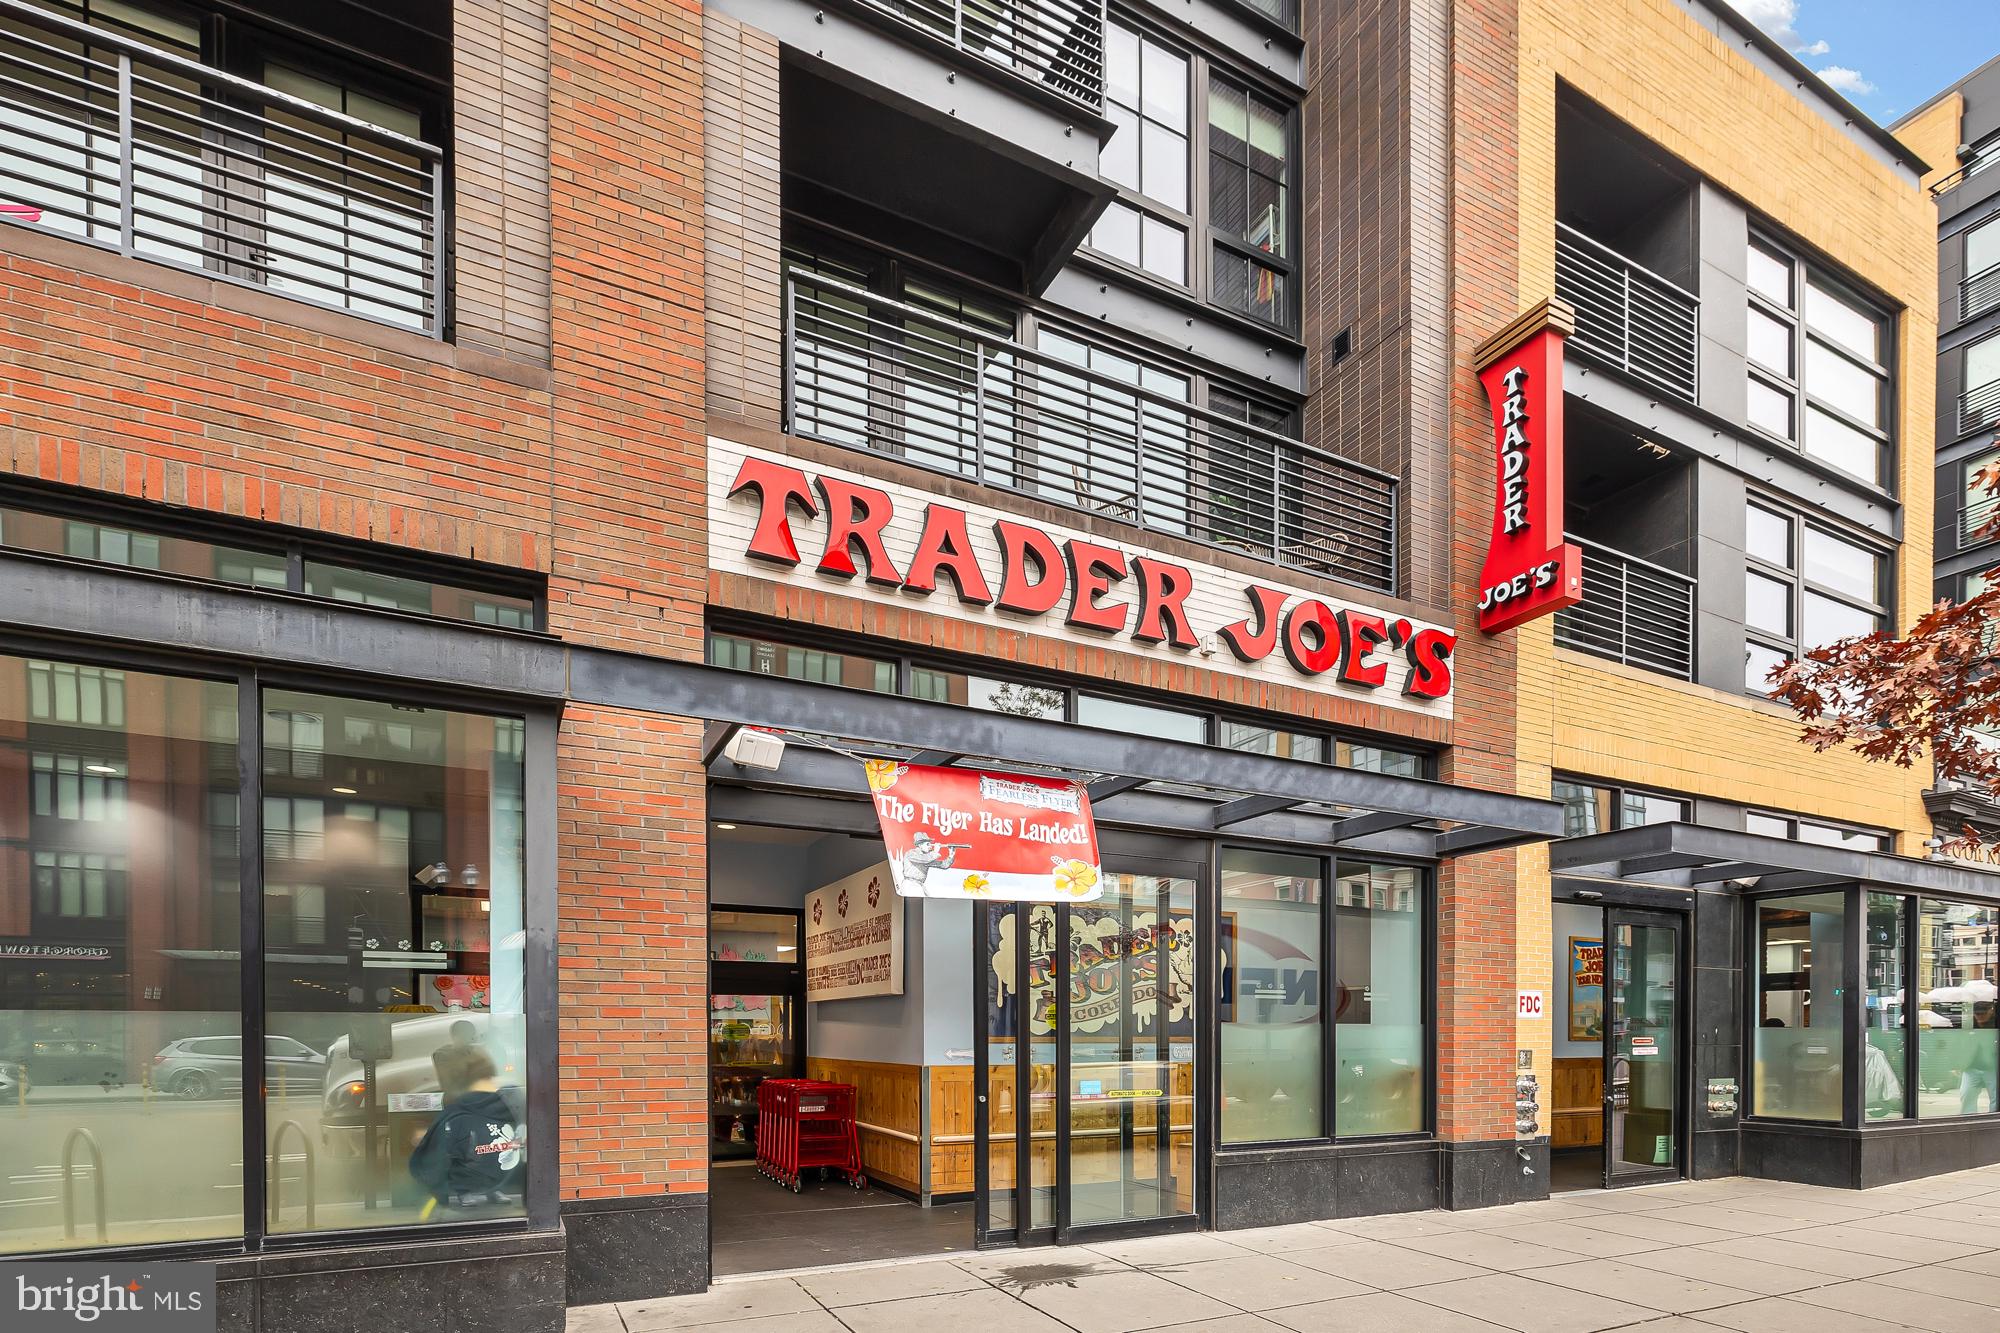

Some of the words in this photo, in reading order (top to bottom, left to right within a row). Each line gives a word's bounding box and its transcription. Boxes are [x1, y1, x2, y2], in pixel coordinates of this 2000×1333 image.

[1501, 366, 1531, 535] TRADER
[728, 456, 1200, 650] TRADER
[1216, 584, 1458, 701] JOE'S
[1477, 560, 1560, 611] JOE'S
[989, 785, 1037, 802] FEARLESS
[1041, 794, 1072, 808] FLYER
[997, 782, 1021, 791] TRADER
[1022, 786, 1040, 794] JOE'S
[877, 795, 914, 823] The
[921, 802, 973, 836] Flyer
[979, 812, 1013, 837] Has
[1019, 817, 1089, 845] Landed!
[1580, 947, 1603, 960] TRAD
[1585, 961, 1603, 972] JOE
[1074, 986, 1159, 1020] CORDO
[1519, 995, 1540, 1013] FDC
